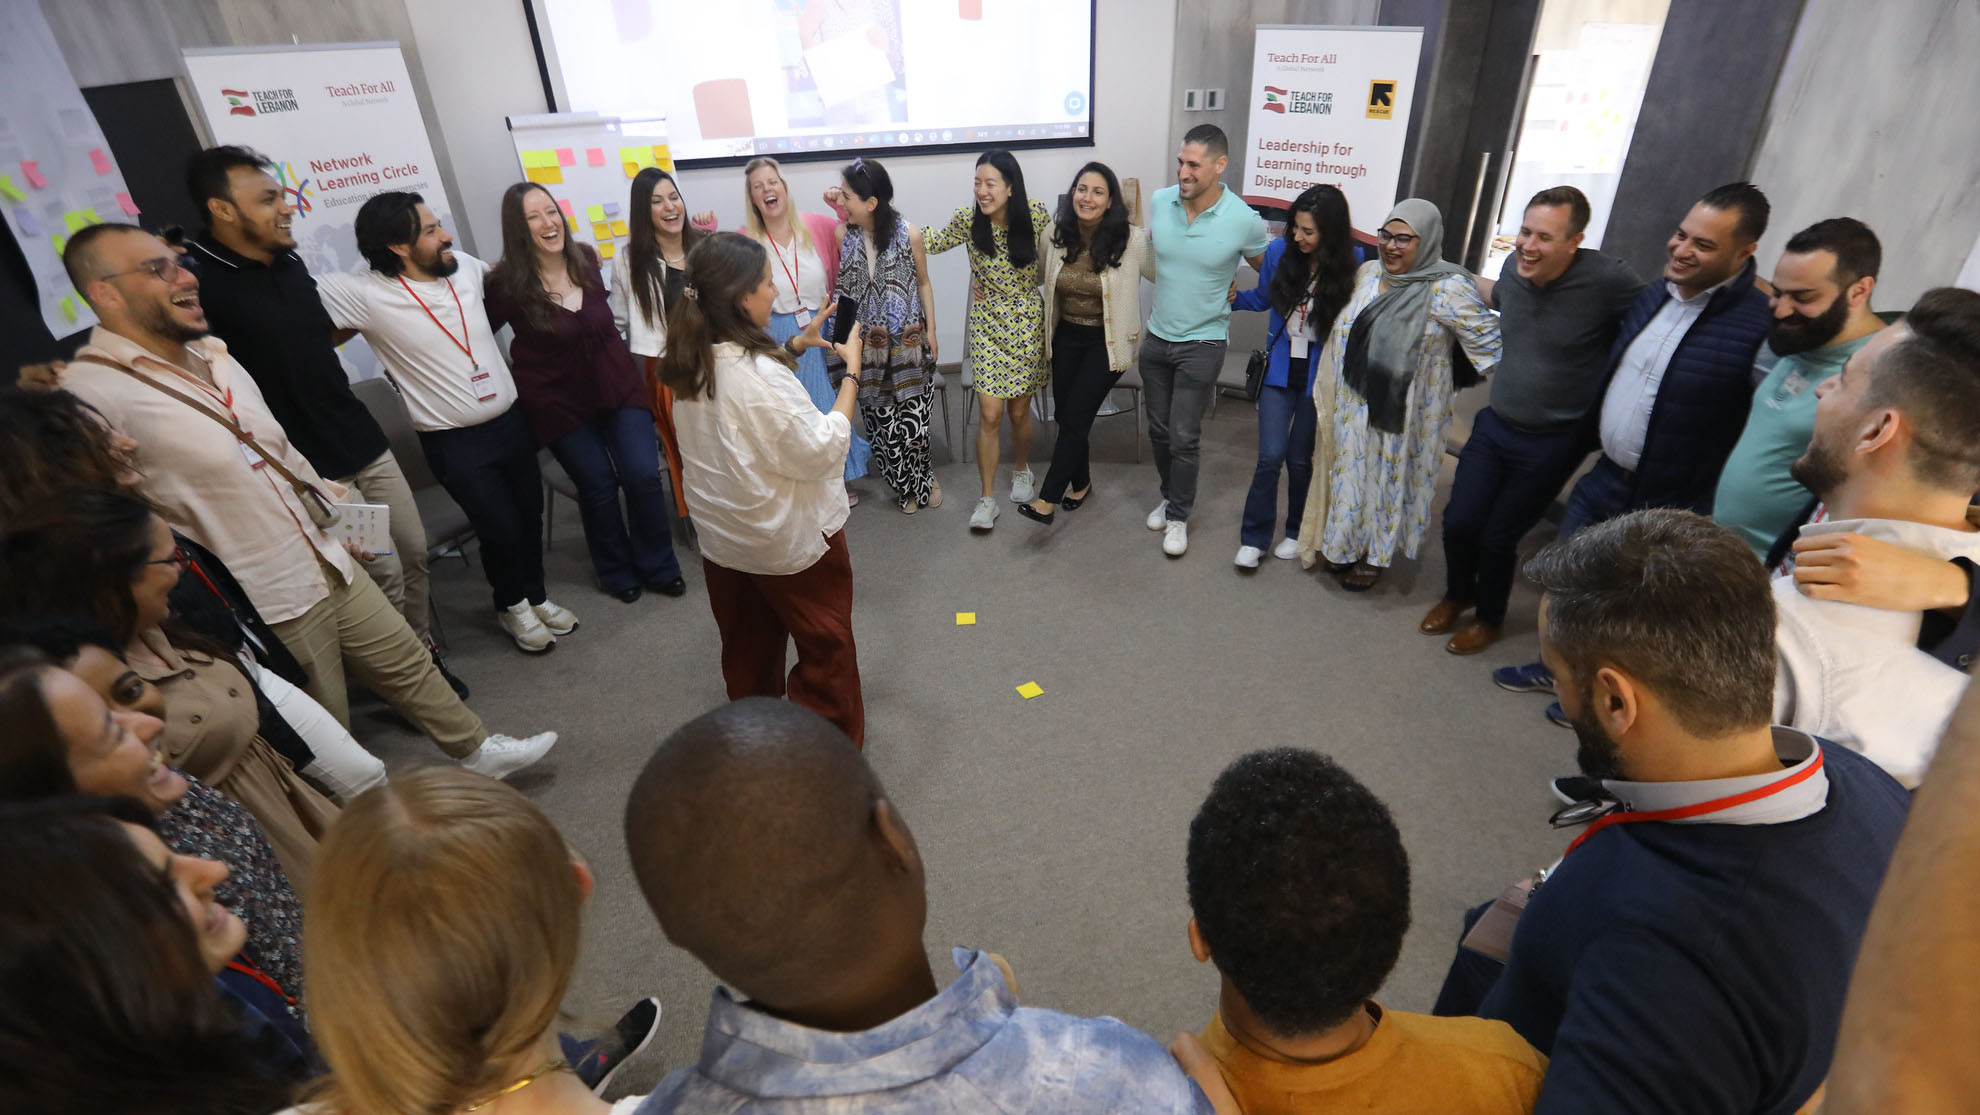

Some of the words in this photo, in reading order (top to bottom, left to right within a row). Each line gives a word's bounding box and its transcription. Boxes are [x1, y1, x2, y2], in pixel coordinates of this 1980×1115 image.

[1267, 53, 1299, 63] Teach
[1301, 53, 1319, 63] For
[1320, 54, 1337, 64] All
[252, 90, 279, 102] TEACH
[278, 89, 295, 99] FOR
[325, 84, 360, 97] Teach
[360, 83, 378, 95] For
[381, 80, 396, 92] All
[1291, 91, 1316, 102] TEACH
[1317, 92, 1333, 102] FOR
[256, 100, 299, 114] LEBANON
[1289, 102, 1332, 114] LEBANON
[1258, 138, 1330, 157] Leadership
[1334, 142, 1354, 156] for
[310, 152, 373, 174] Network
[1257, 157, 1312, 174] Learning
[1316, 161, 1367, 179] through
[317, 172, 380, 191] Learning
[382, 164, 419, 180] Circle
[1255, 174, 1343, 190] Displacet
[323, 192, 368, 208] Education
